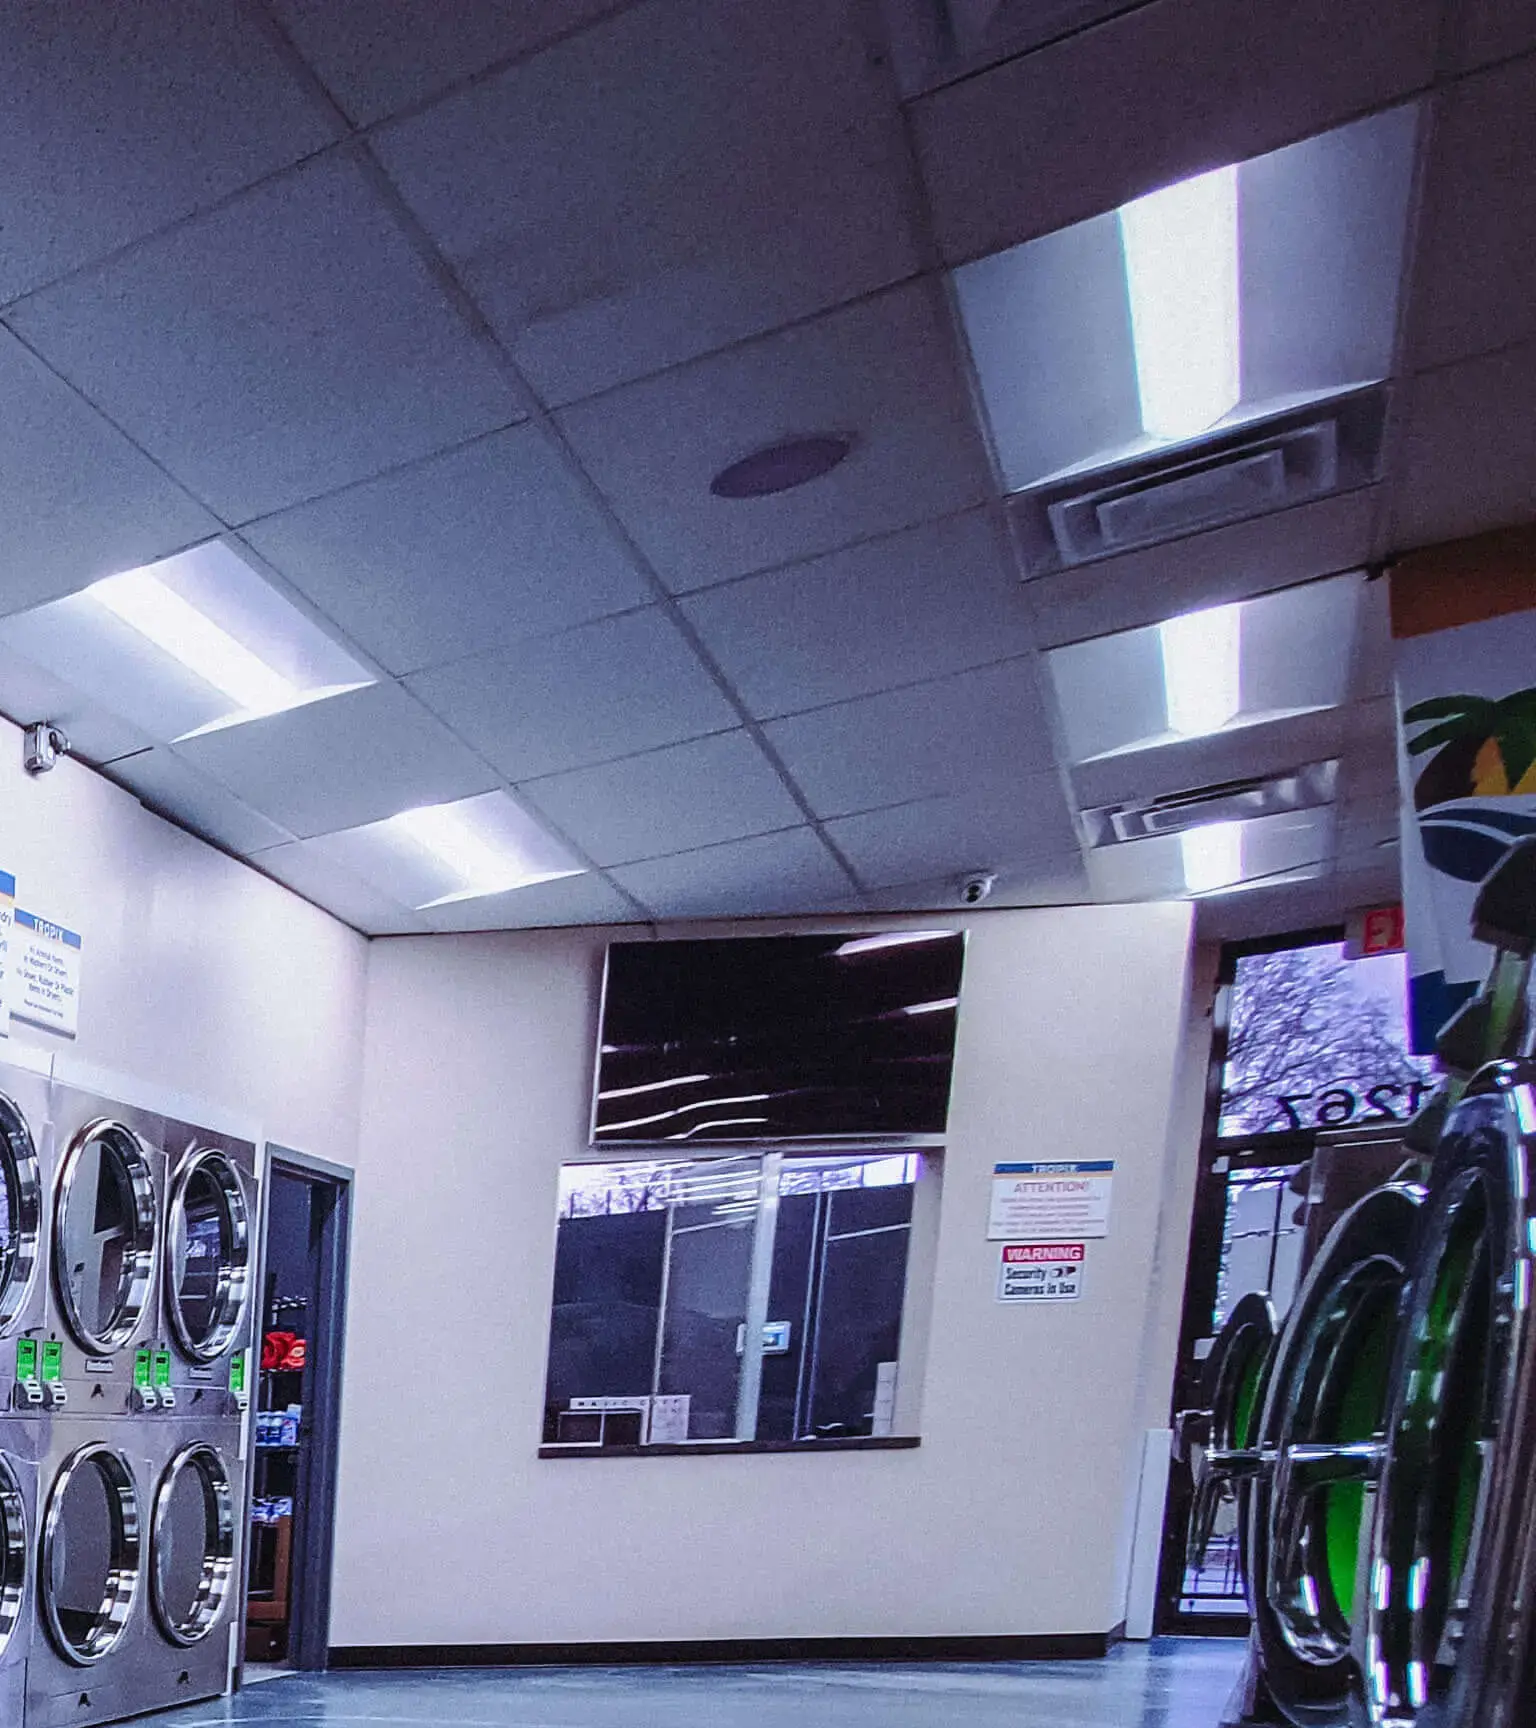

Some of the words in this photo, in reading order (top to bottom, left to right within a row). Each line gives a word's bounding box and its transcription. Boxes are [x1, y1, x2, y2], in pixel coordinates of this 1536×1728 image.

[1006, 1247, 1081, 1261] WARNING
[1005, 1266, 1047, 1281] Security
[1004, 1282, 1044, 1296] Cameras
[1058, 1282, 1076, 1294] Use
